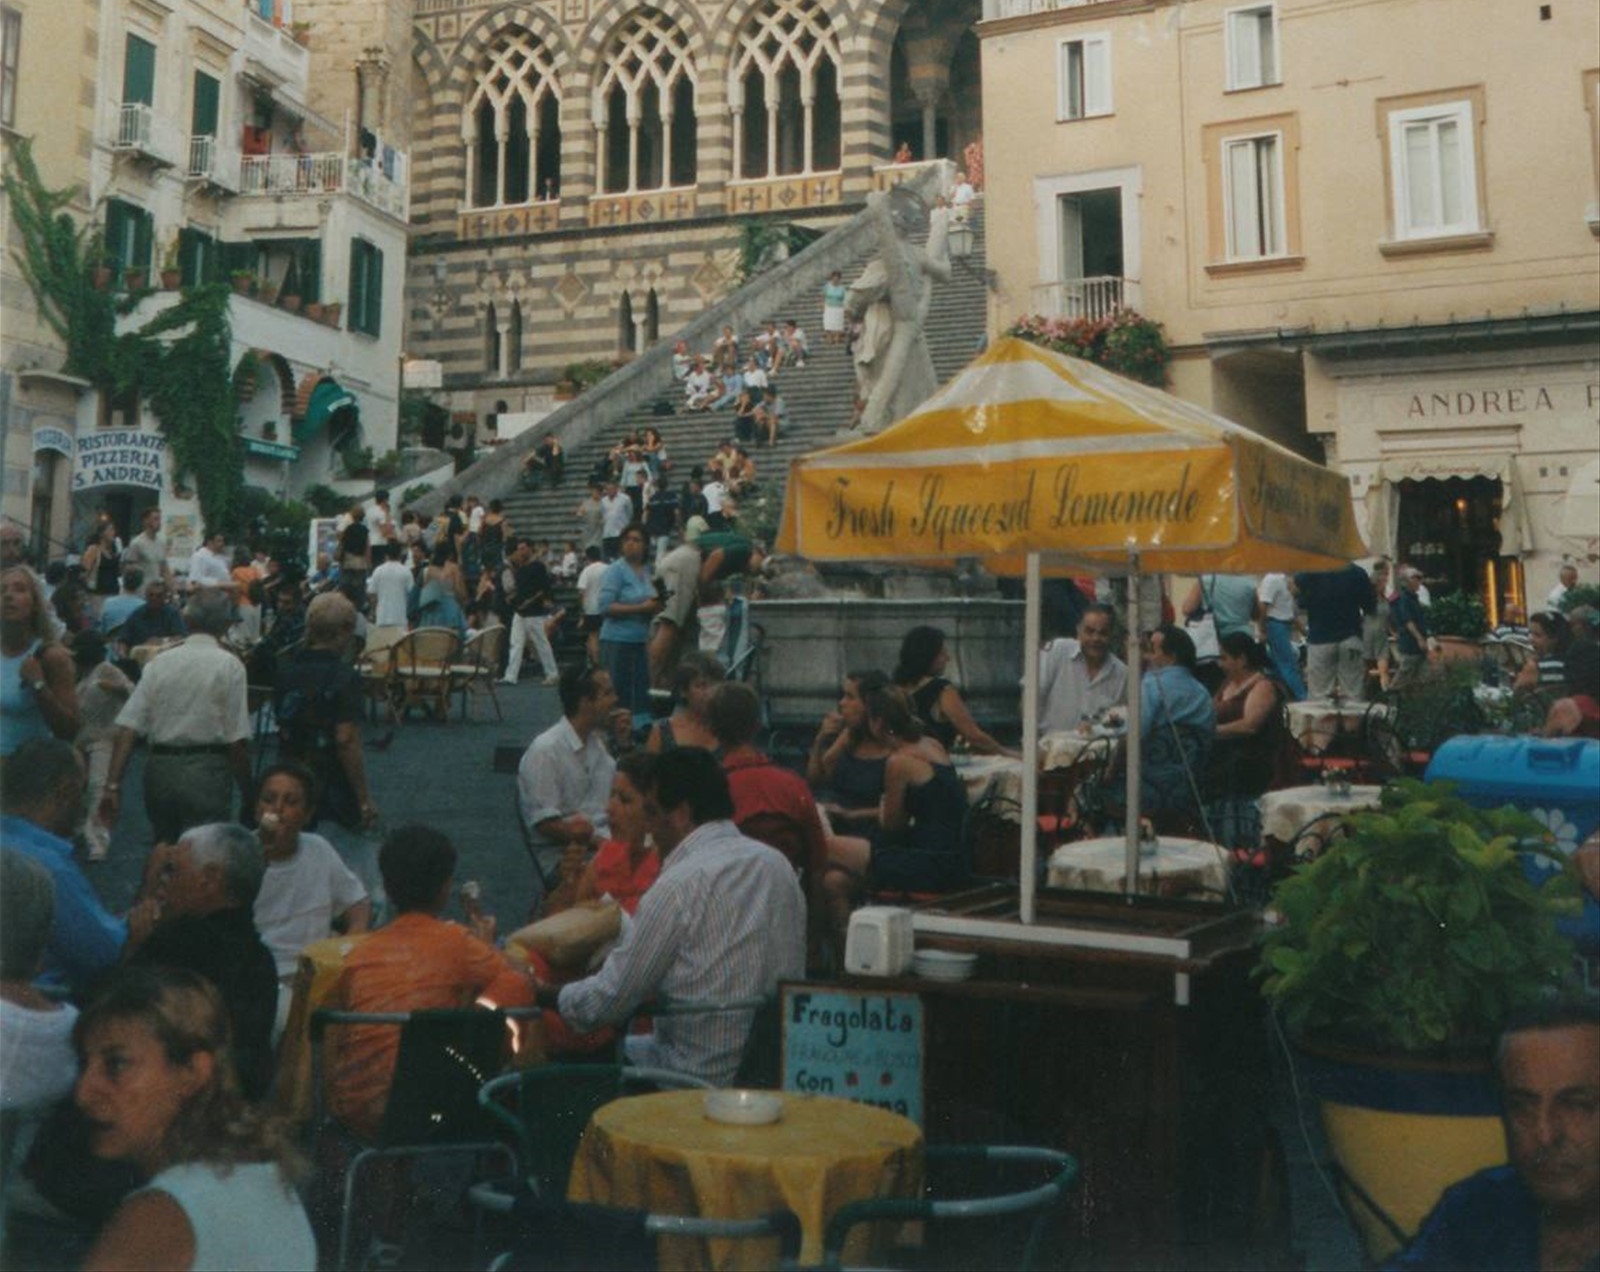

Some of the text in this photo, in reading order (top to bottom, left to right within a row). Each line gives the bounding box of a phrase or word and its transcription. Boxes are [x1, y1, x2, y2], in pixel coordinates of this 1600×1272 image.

[1408, 387, 1555, 418] ANDREA
[77, 433, 166, 451] RISTORANTE
[81, 450, 160, 469] PIZZERIA
[92, 466, 164, 488] ANDREA
[826, 476, 896, 540] Fresh
[911, 469, 1037, 551] Squeezed
[1050, 462, 1200, 528] Lemonade
[793, 994, 912, 1047] Fragolata
